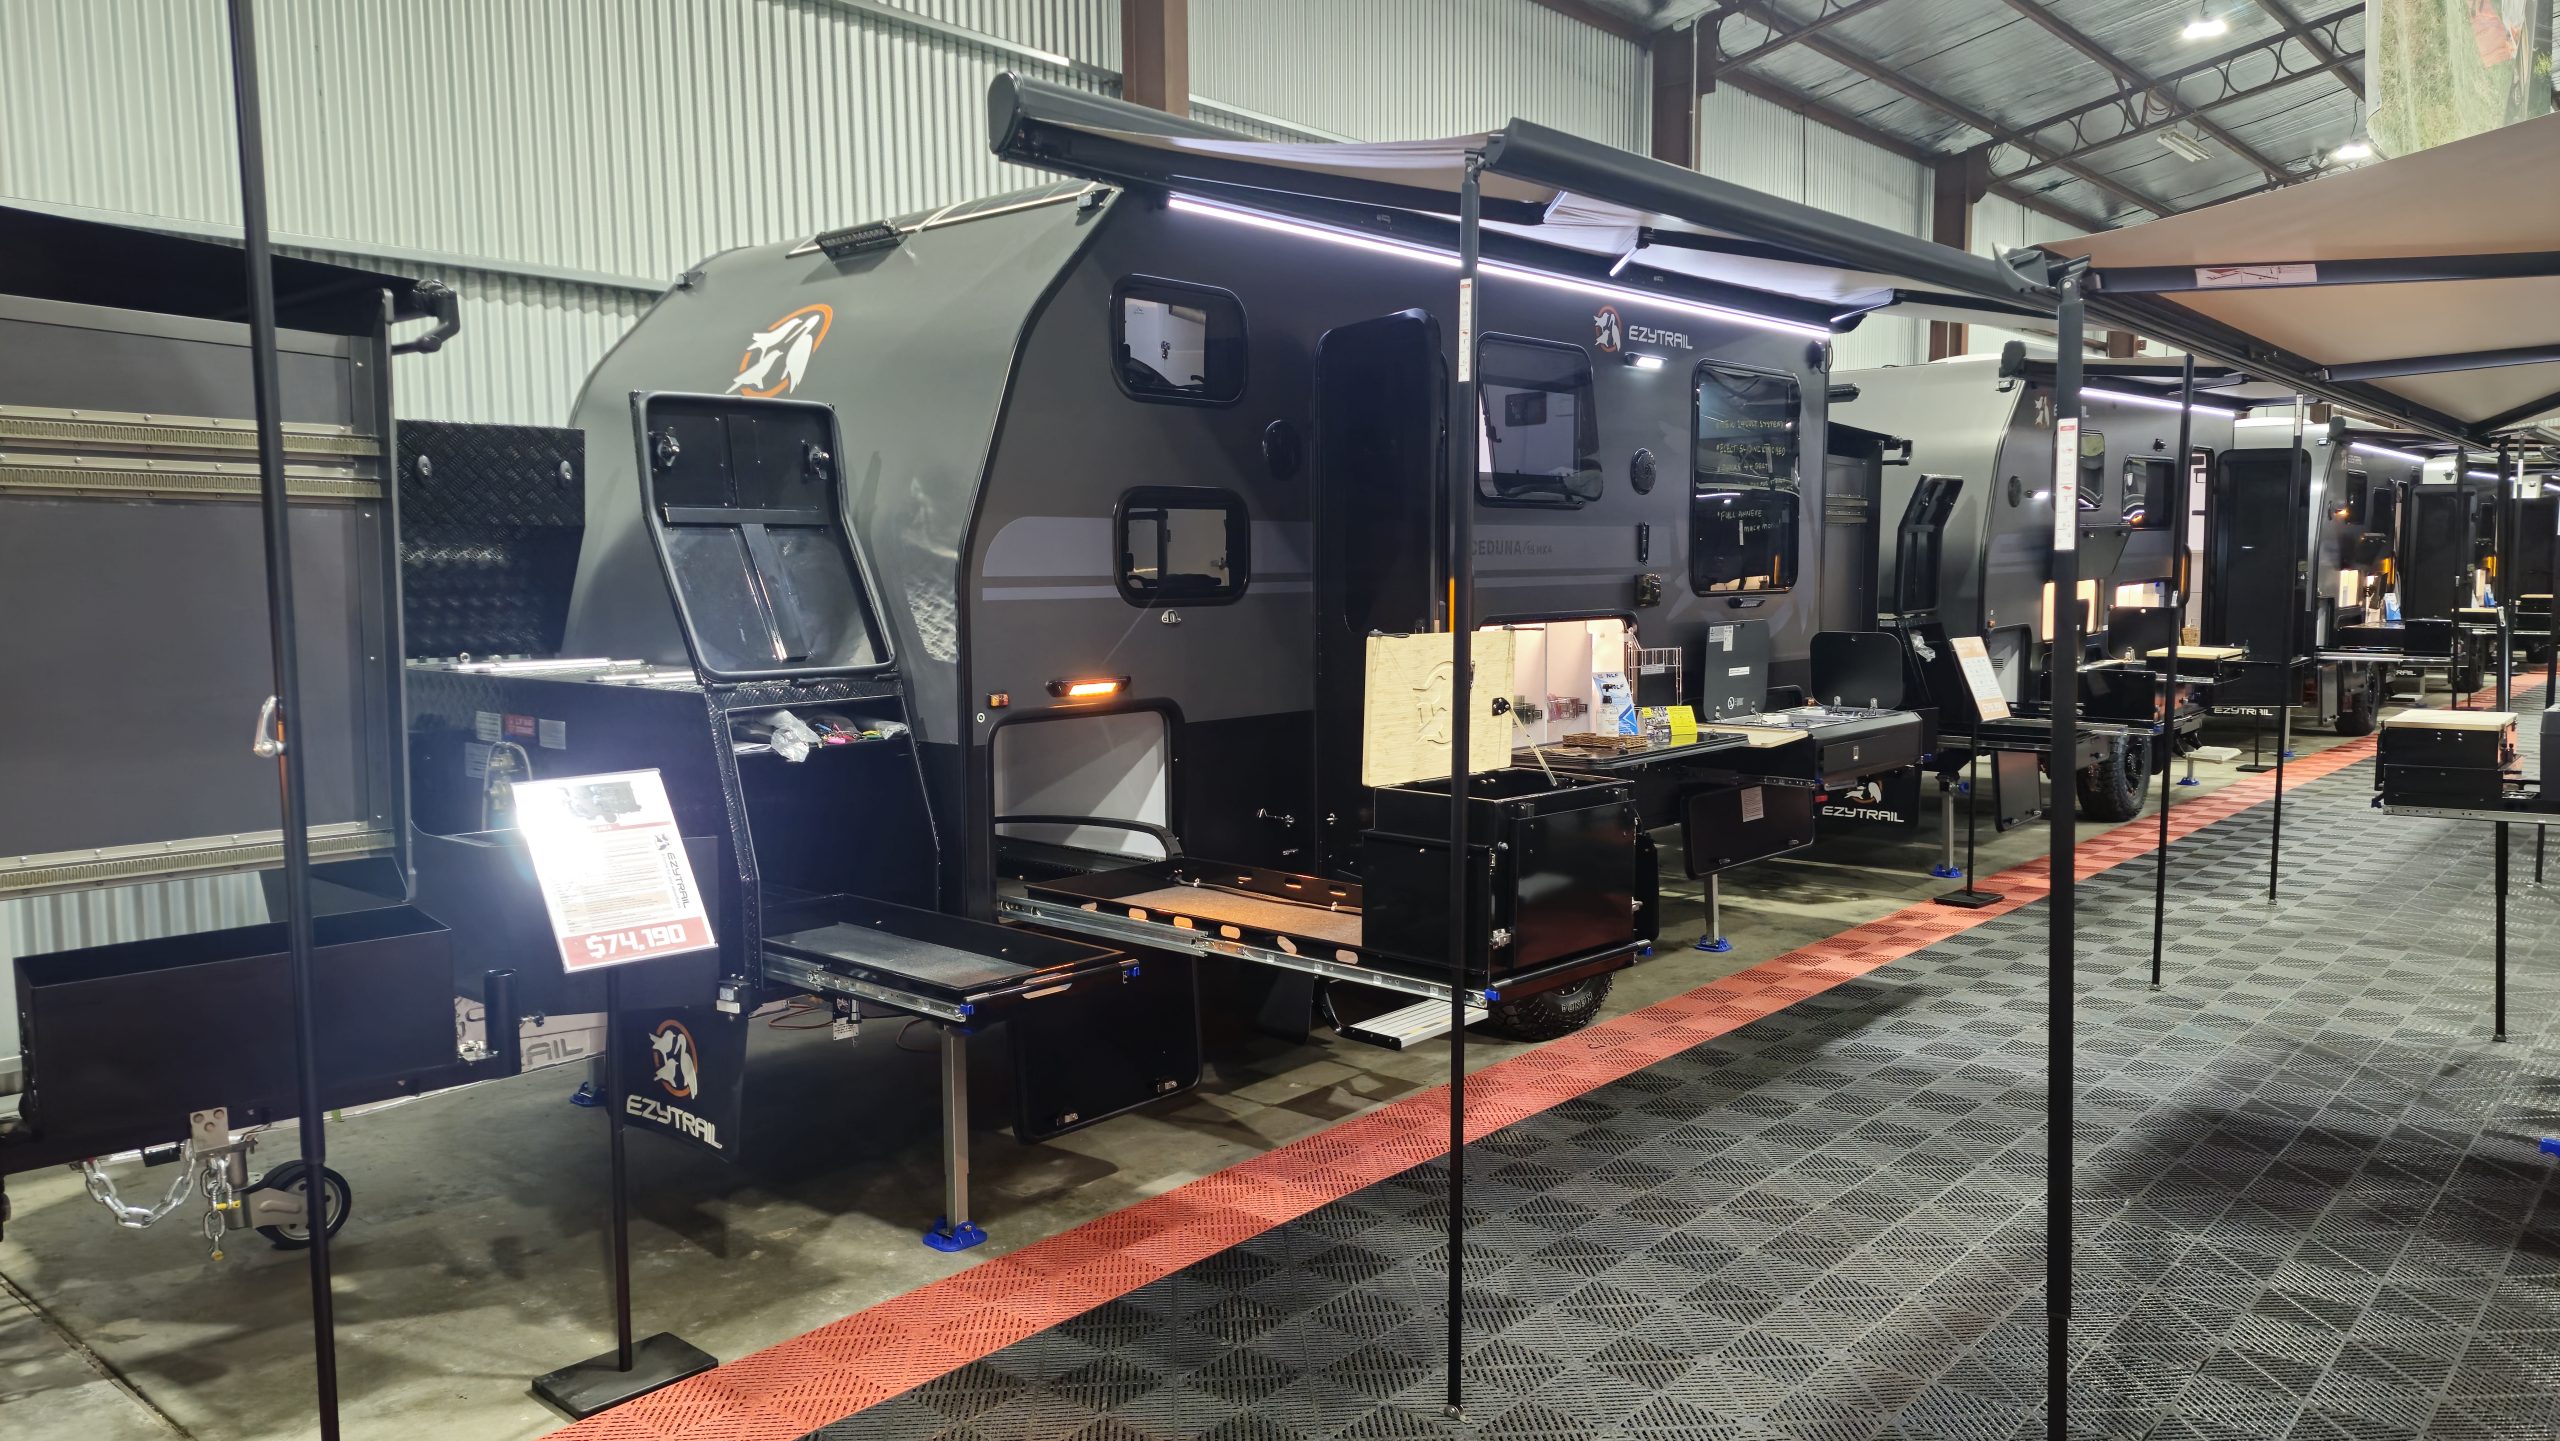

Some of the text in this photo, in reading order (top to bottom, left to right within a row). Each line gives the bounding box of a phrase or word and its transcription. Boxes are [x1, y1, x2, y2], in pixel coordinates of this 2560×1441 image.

[1628, 325, 1693, 350] EZYTRAIL
[1821, 805, 1905, 823] EZYTRAIL
[667, 852, 690, 909] EZYTRAIL
[585, 924, 687, 959] $74,190
[626, 1094, 723, 1150] EZYTRAIL
